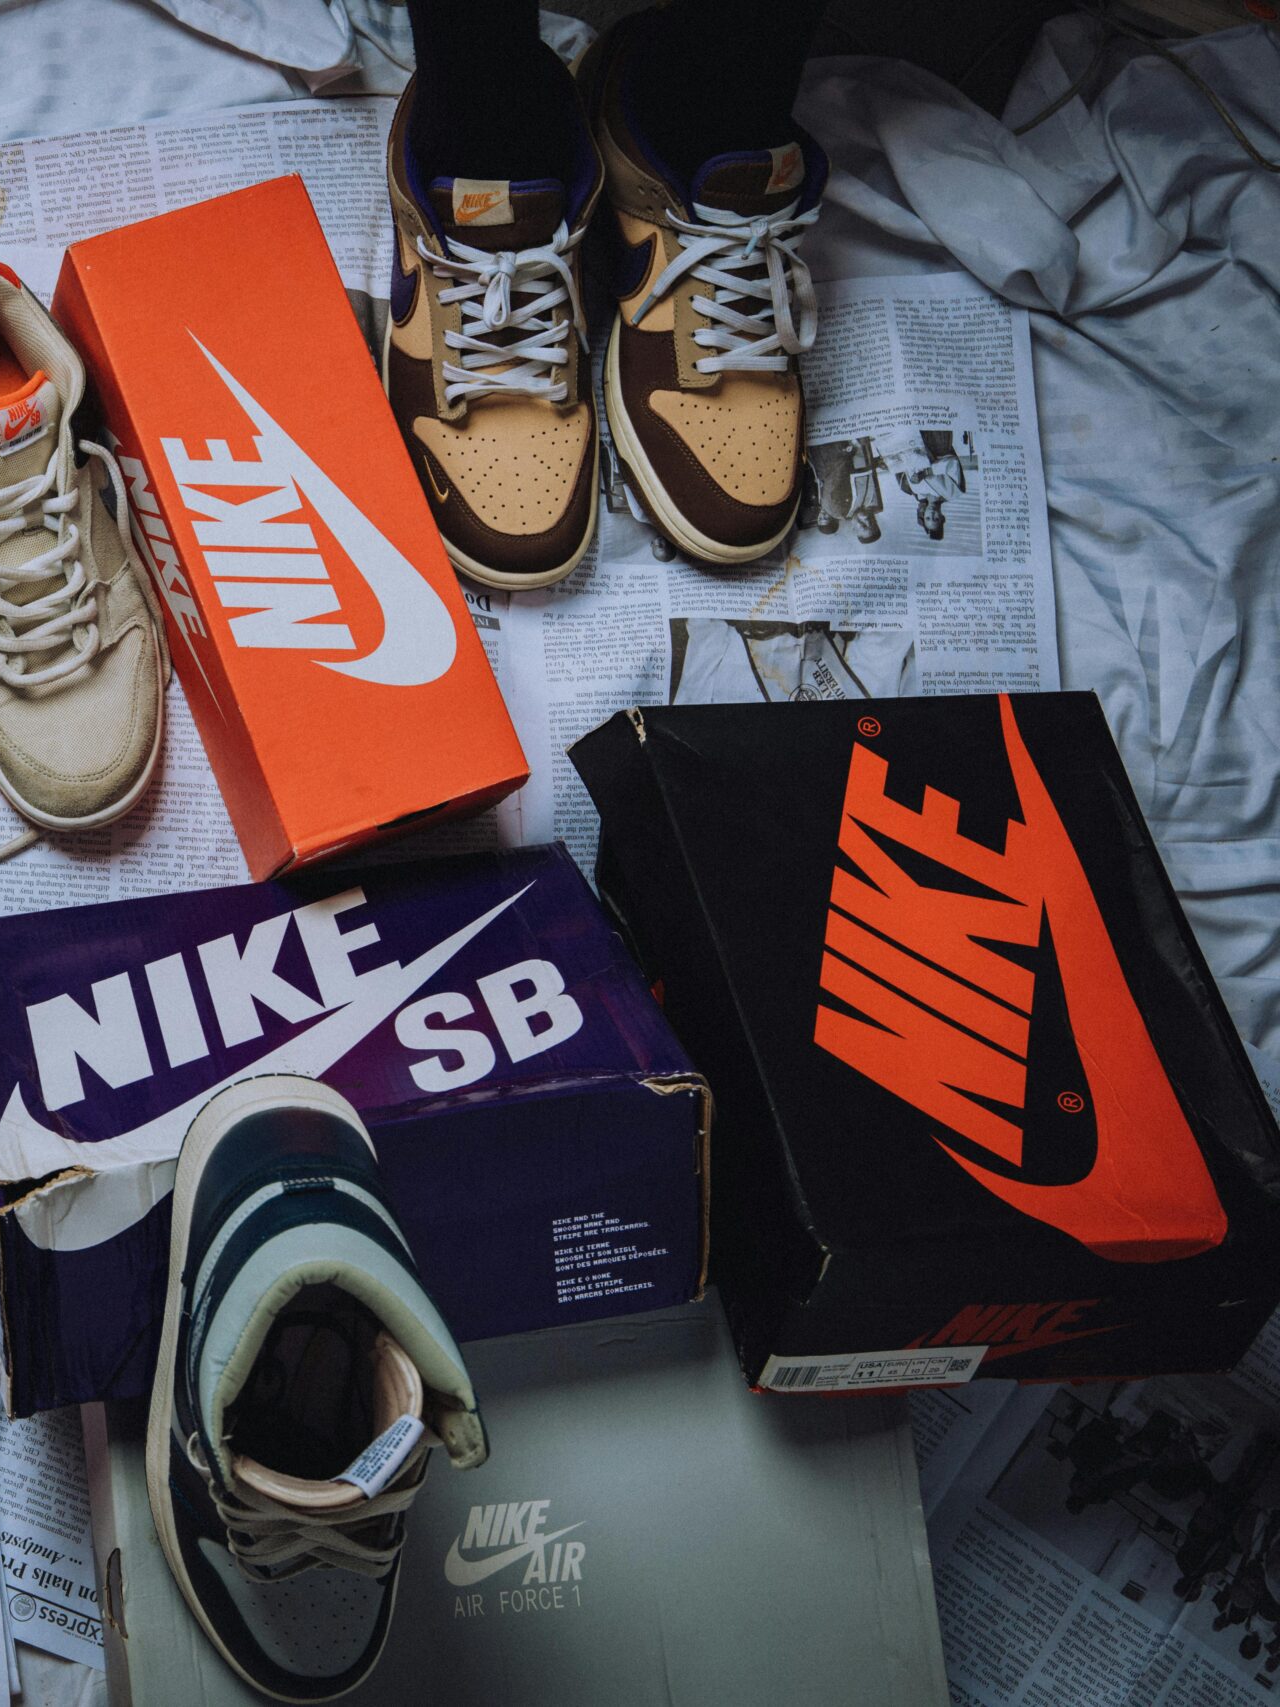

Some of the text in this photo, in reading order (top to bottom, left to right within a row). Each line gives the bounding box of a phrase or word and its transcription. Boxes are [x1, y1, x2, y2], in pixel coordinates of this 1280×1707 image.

[462, 194, 492, 208] NIKE
[8, 403, 32, 422] NIKE
[27, 410, 40, 427] SB
[119, 454, 208, 639] NIKE
[158, 436, 360, 651] NIKE
[465, 590, 491, 612] Do
[814, 741, 1048, 1167] NIKE
[27, 886, 584, 1112] NIKE SB
[554, 1232, 581, 1241] STRIPE
[614, 1246, 636, 1254] SIGLE
[556, 1264, 574, 1272] SONT
[932, 1299, 1100, 1346] NIKE
[463, 1499, 552, 1550] NIKE
[0, 1532, 65, 1564] Analysts
[523, 1541, 586, 1585] AIR
[33, 1568, 73, 1597] hails
[454, 1585, 582, 1617] AIR FORCE 1
